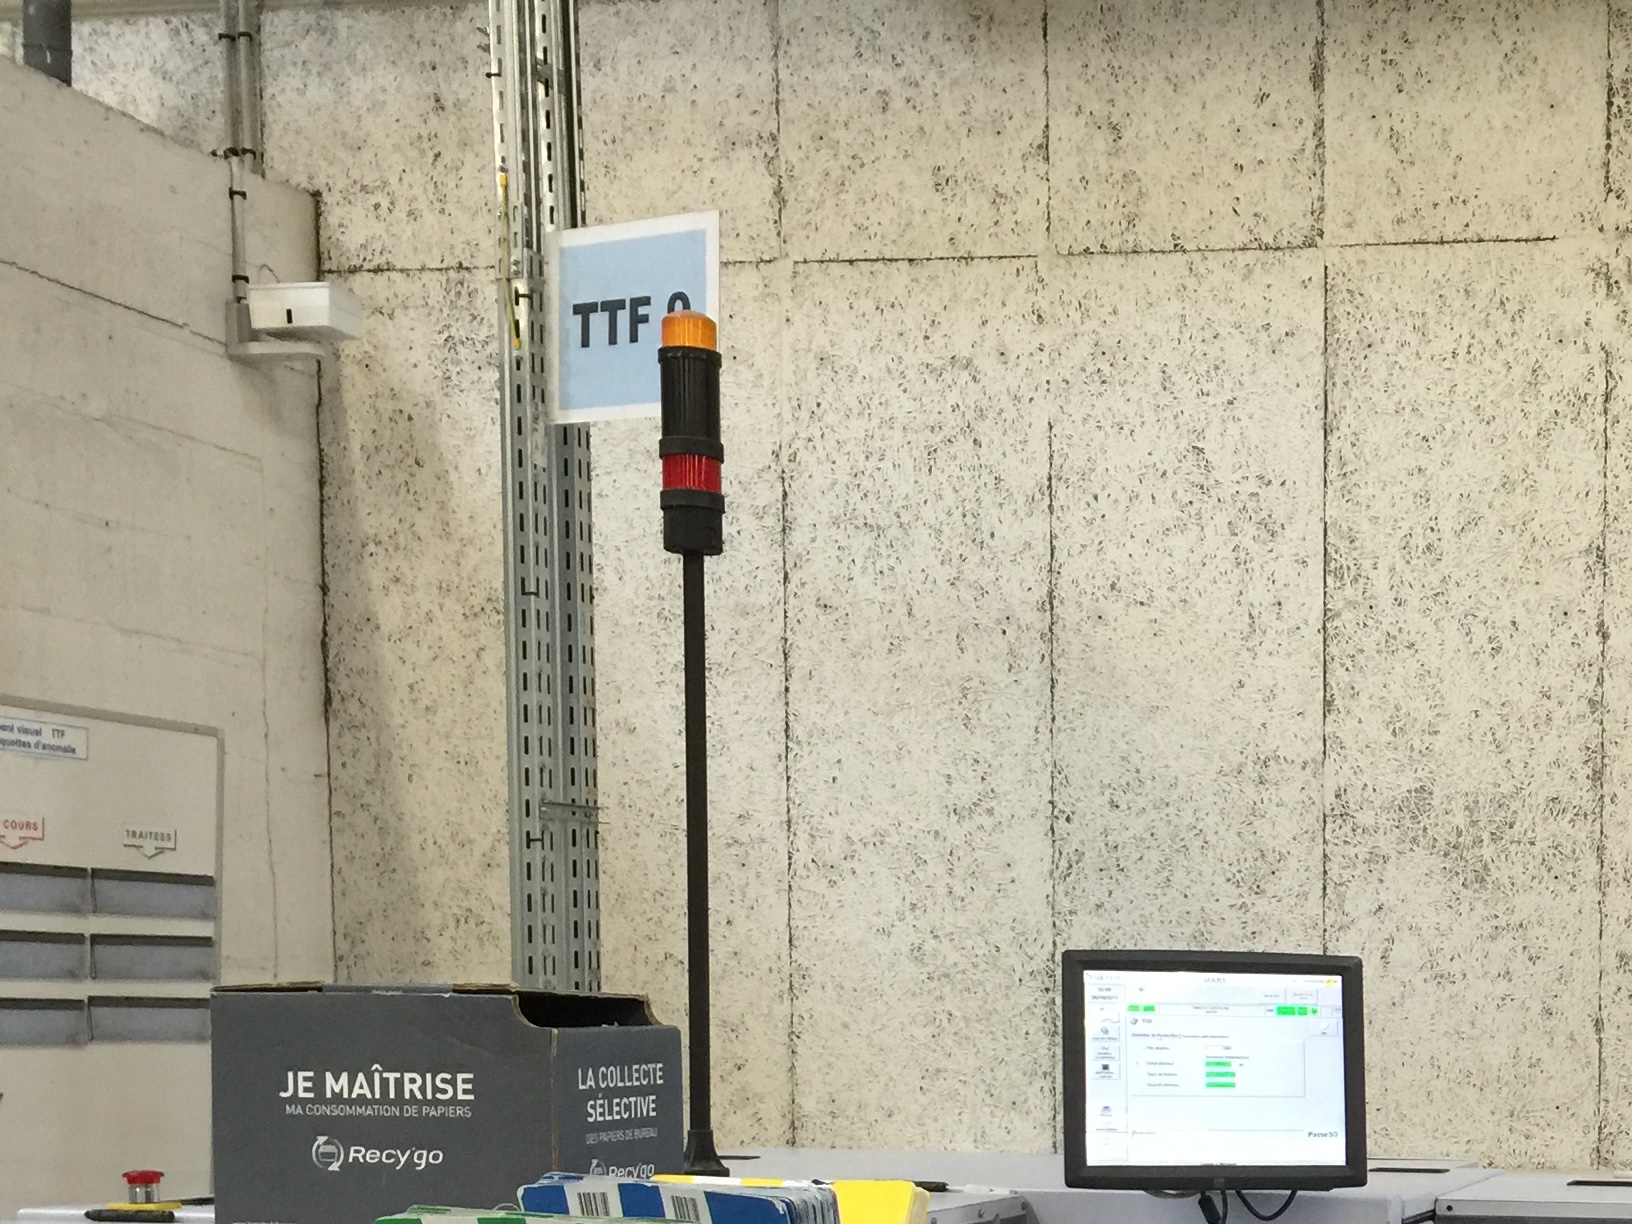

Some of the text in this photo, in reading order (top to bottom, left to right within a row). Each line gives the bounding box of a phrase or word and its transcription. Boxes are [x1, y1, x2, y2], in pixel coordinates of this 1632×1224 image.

[572, 296, 651, 348] TTF
[3, 819, 39, 831] COURS
[279, 1064, 475, 1100] JE MAÎTRISE
[578, 1063, 664, 1090] LA COLLECTE
[285, 1104, 472, 1118] MA CONSOMMATION DE PAPIERS
[587, 1093, 657, 1122] SÉLECTIVE
